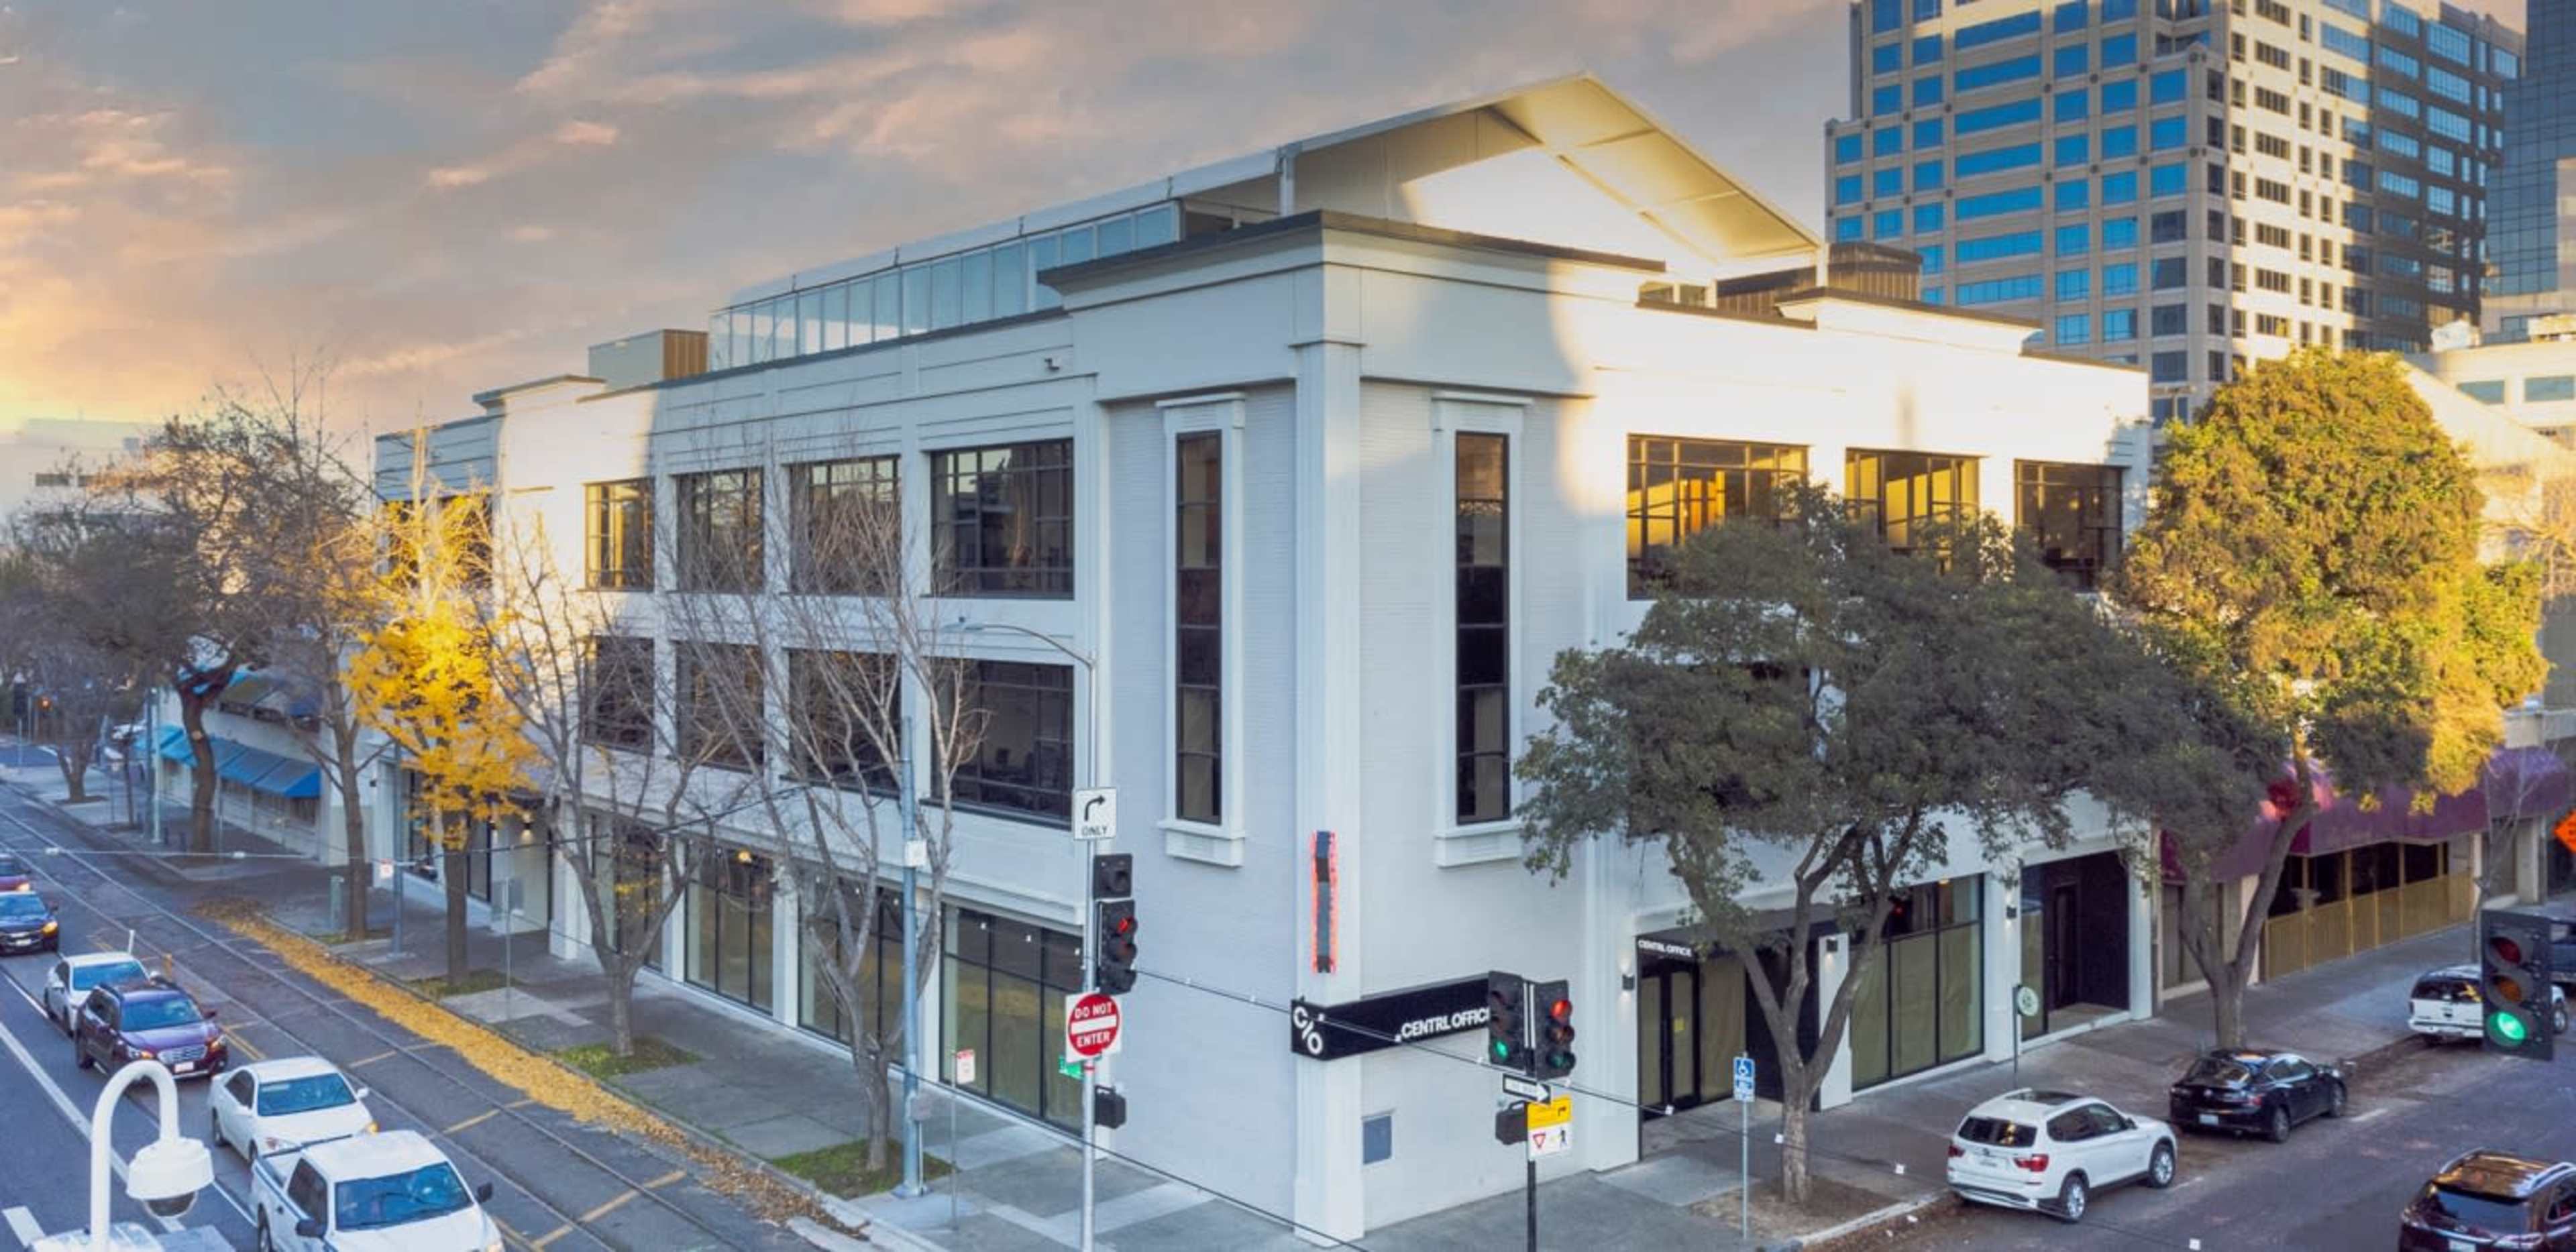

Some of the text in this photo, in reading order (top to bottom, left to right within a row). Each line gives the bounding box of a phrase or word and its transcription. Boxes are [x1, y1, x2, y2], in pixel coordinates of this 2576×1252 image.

[1081, 826, 1107, 836] ONLY
[1075, 1001, 1112, 1019] DO NOT
[1401, 1015, 1451, 1039] CENTRL
[1077, 1031, 1110, 1048] ENTER
